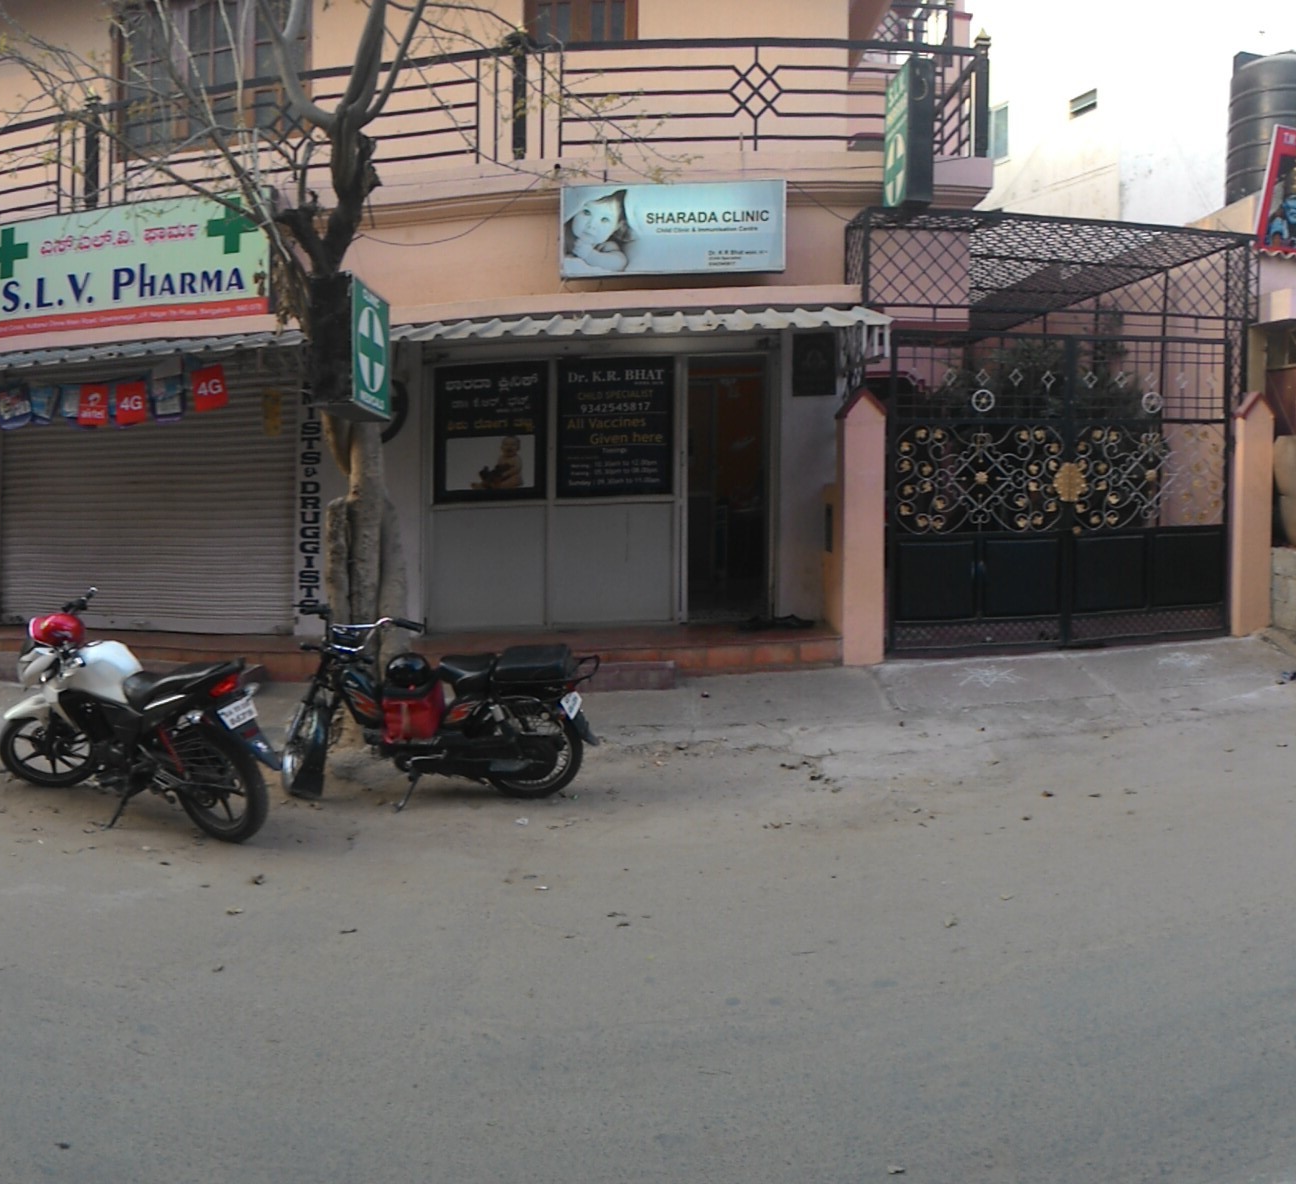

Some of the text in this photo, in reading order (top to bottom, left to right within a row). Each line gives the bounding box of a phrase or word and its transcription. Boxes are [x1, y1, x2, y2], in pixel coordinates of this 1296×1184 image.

[646, 210, 770, 224] SHARADA CLINIC
[2, 272, 95, 313] S.L.V.
[568, 369, 664, 382] Dr. K.R. BHAT
[197, 378, 223, 397] 4G
[578, 388, 654, 400] CHILD SPECIALIST
[119, 395, 143, 411] 4G
[580, 401, 651, 413] 9342545817
[81, 408, 105, 419] airtel
[567, 416, 646, 429] All Vaccines
[589, 432, 664, 445] Given here
